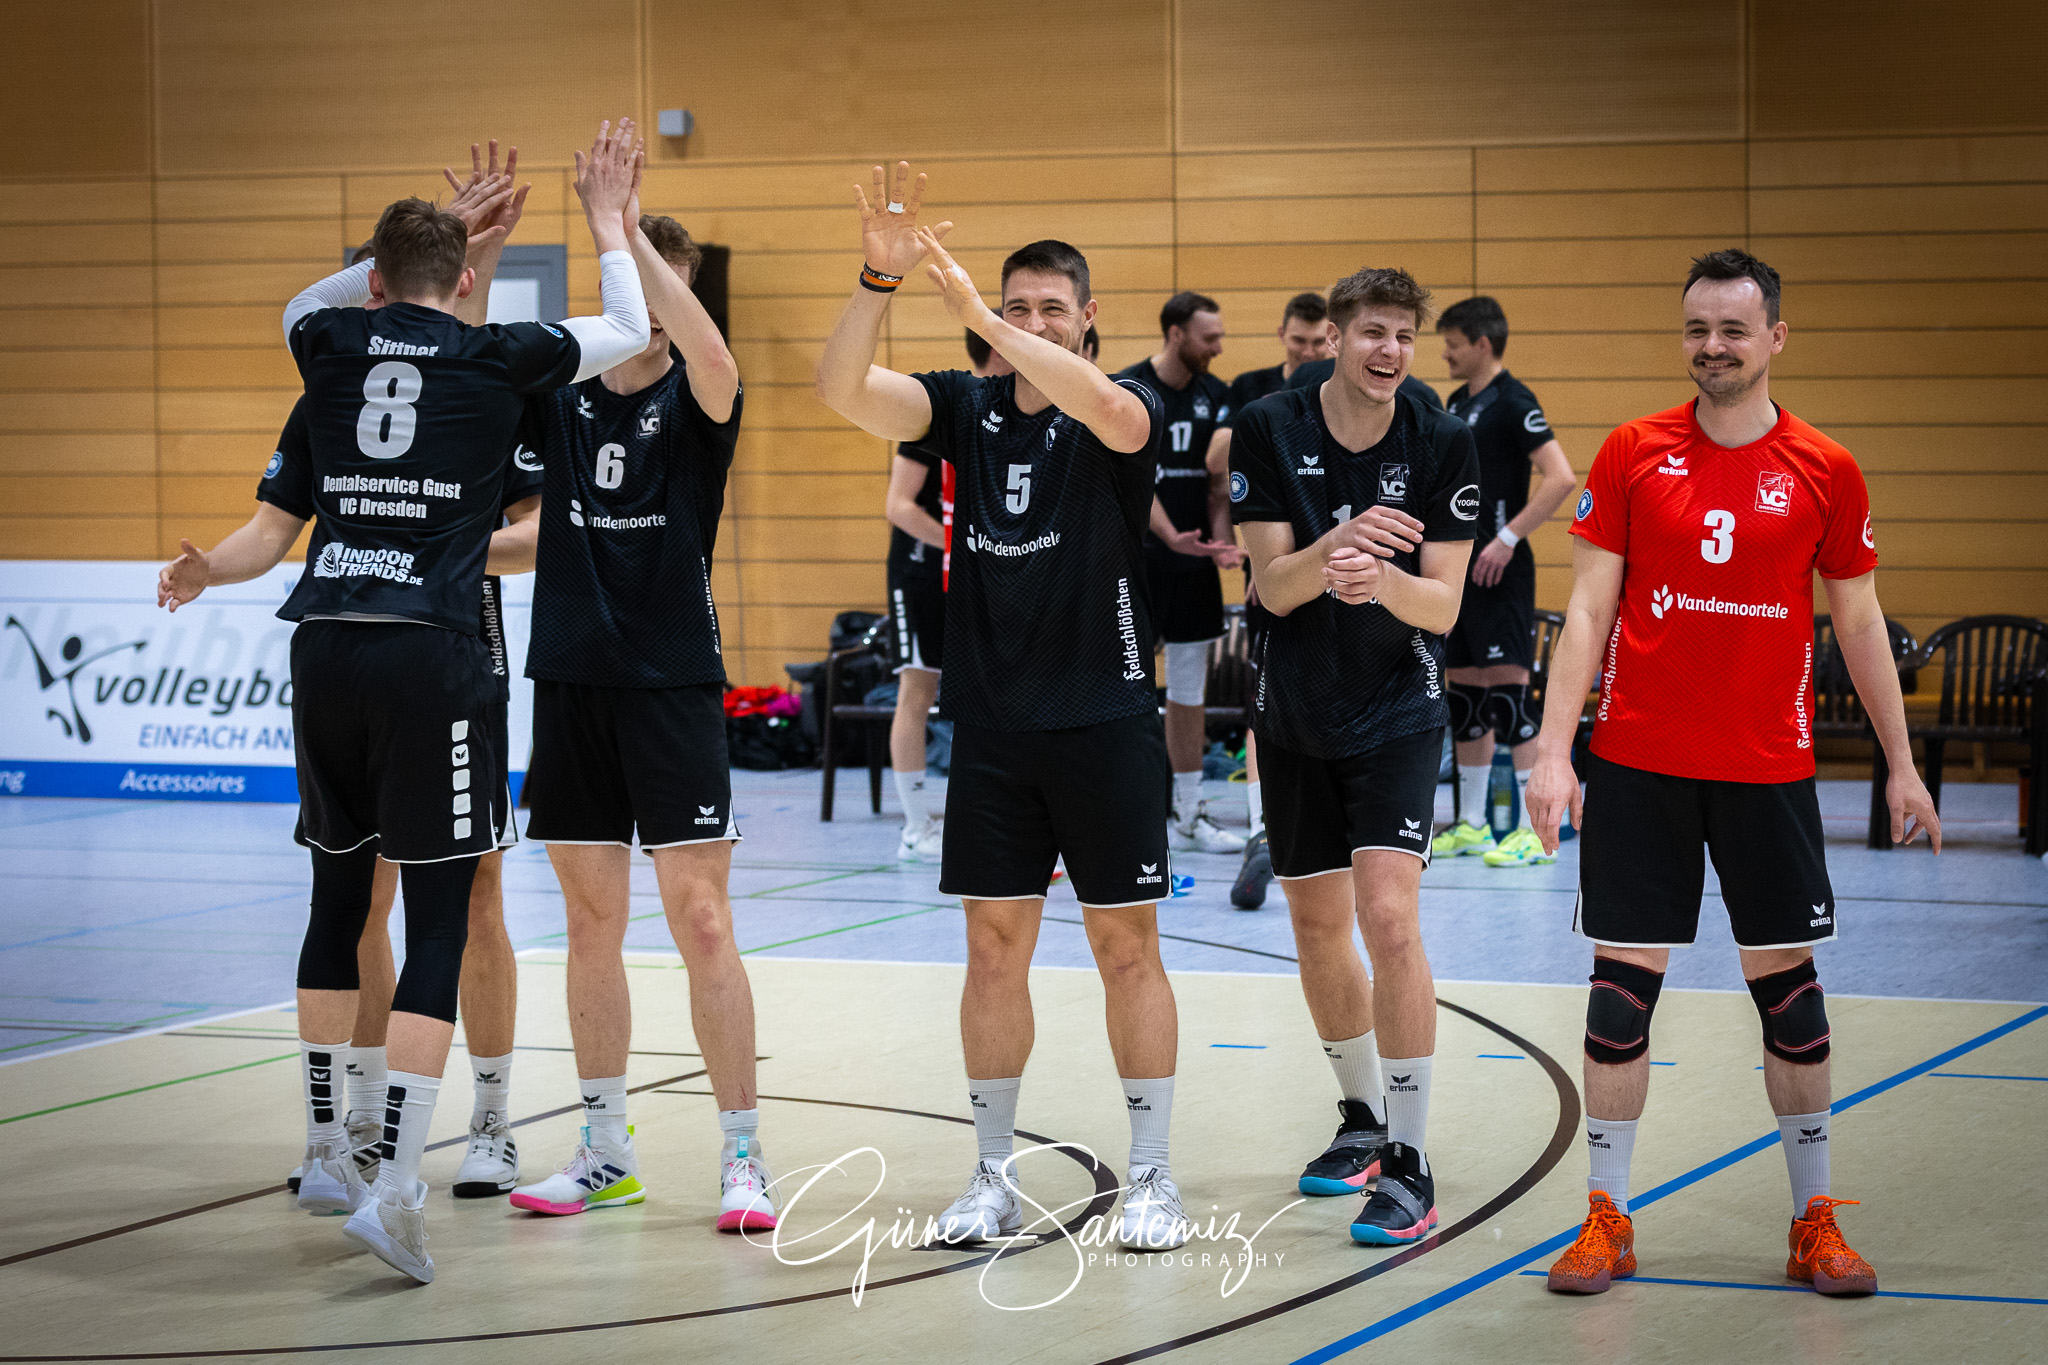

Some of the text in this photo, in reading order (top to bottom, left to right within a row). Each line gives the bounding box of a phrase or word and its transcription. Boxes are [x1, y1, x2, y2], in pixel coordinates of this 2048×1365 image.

[356, 360, 423, 460] 8
[1168, 421, 1193, 452] 17
[595, 443, 626, 489] 6
[1297, 466, 1325, 476] erima
[1658, 466, 1688, 477] erima
[322, 474, 461, 500] Dentalservice Gust
[1005, 463, 1032, 515] 5
[1381, 480, 1406, 497] VC
[1759, 488, 1788, 508] VC
[339, 497, 428, 519] VC Dresden
[1700, 509, 1736, 564] 3
[341, 547, 415, 570] INDOOR
[1676, 592, 1789, 620] Vandemoortele
[138, 723, 247, 750] EINFACH
[119, 767, 247, 794] Accessoires
[694, 816, 720, 825] erima
[1399, 829, 1423, 841] erima
[1136, 875, 1163, 884] erima
[1809, 916, 1832, 928] erima
[1389, 1083, 1419, 1092] erima
[1797, 1134, 1828, 1145] erima
